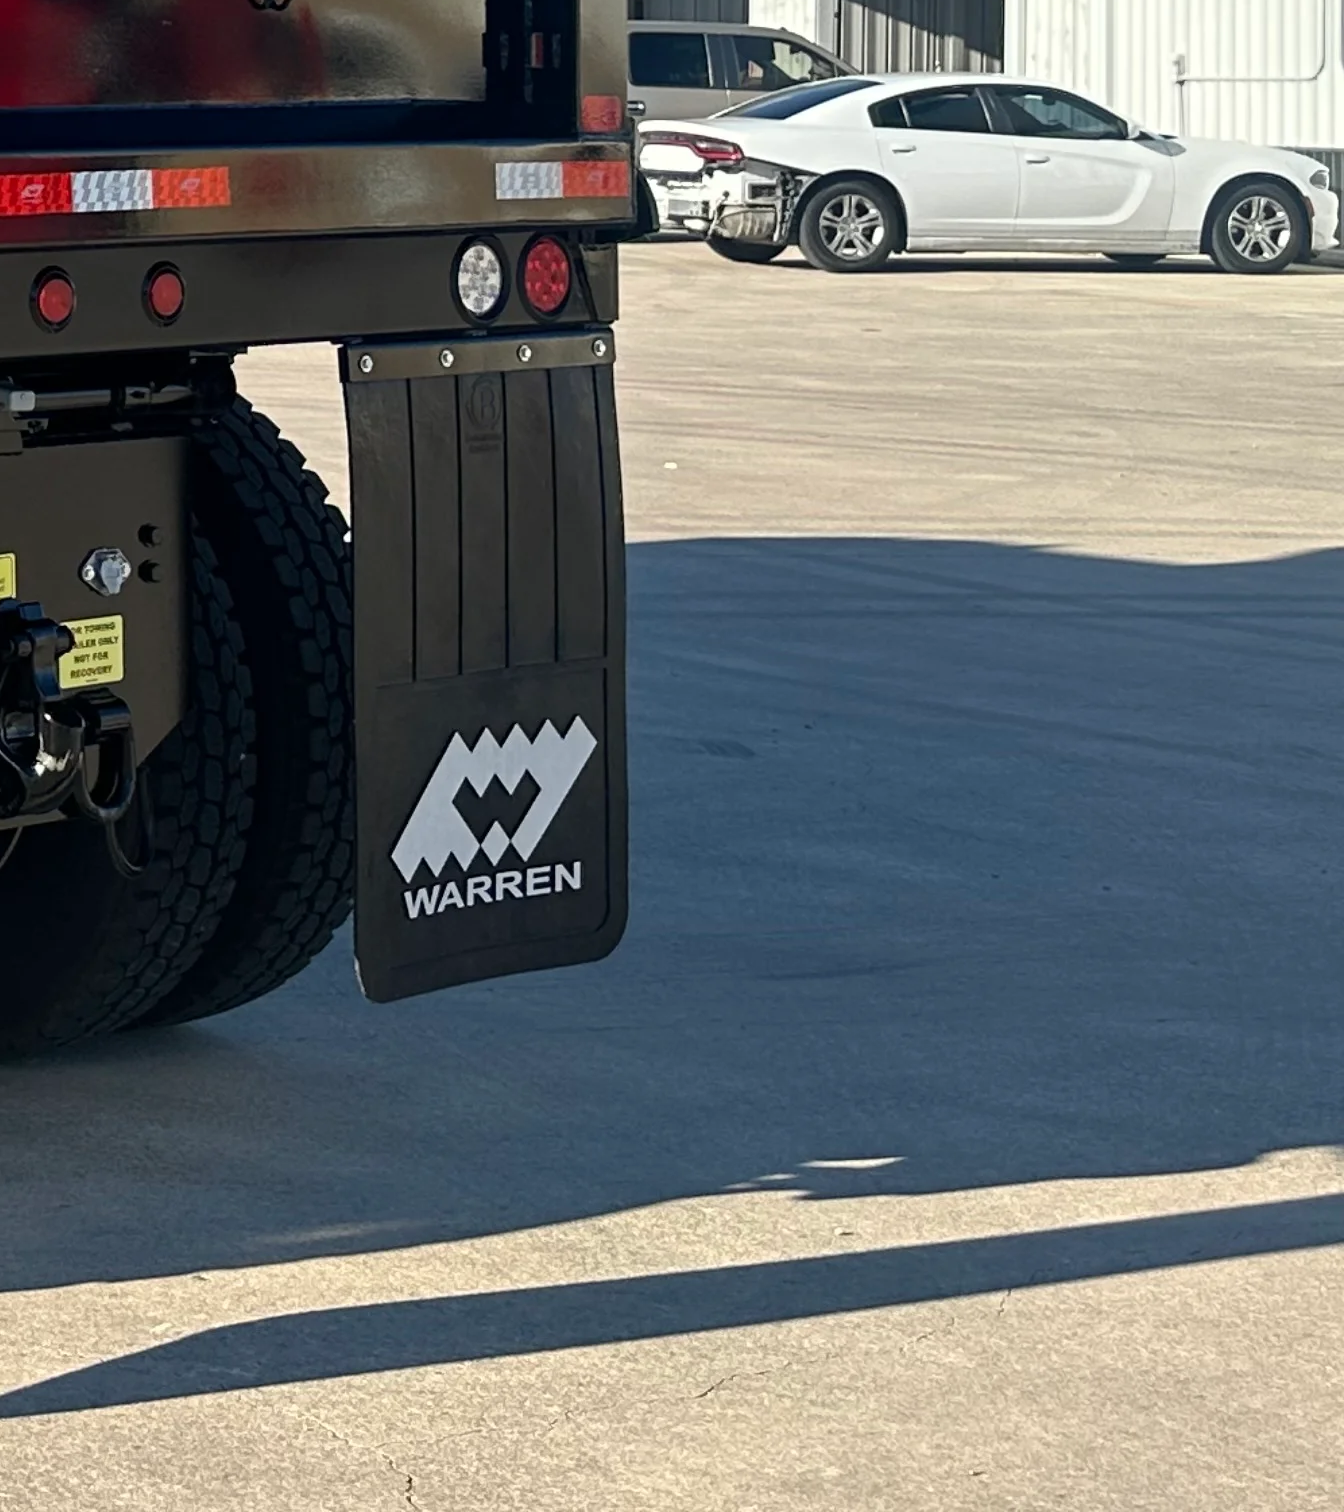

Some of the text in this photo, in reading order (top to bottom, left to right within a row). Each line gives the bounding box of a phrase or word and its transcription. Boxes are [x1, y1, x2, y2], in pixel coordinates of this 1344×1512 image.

[98, 636, 119, 646] ONLY
[74, 651, 109, 664] NOT FOR
[70, 665, 113, 679] RECOVERY
[403, 861, 582, 920] WARREN
